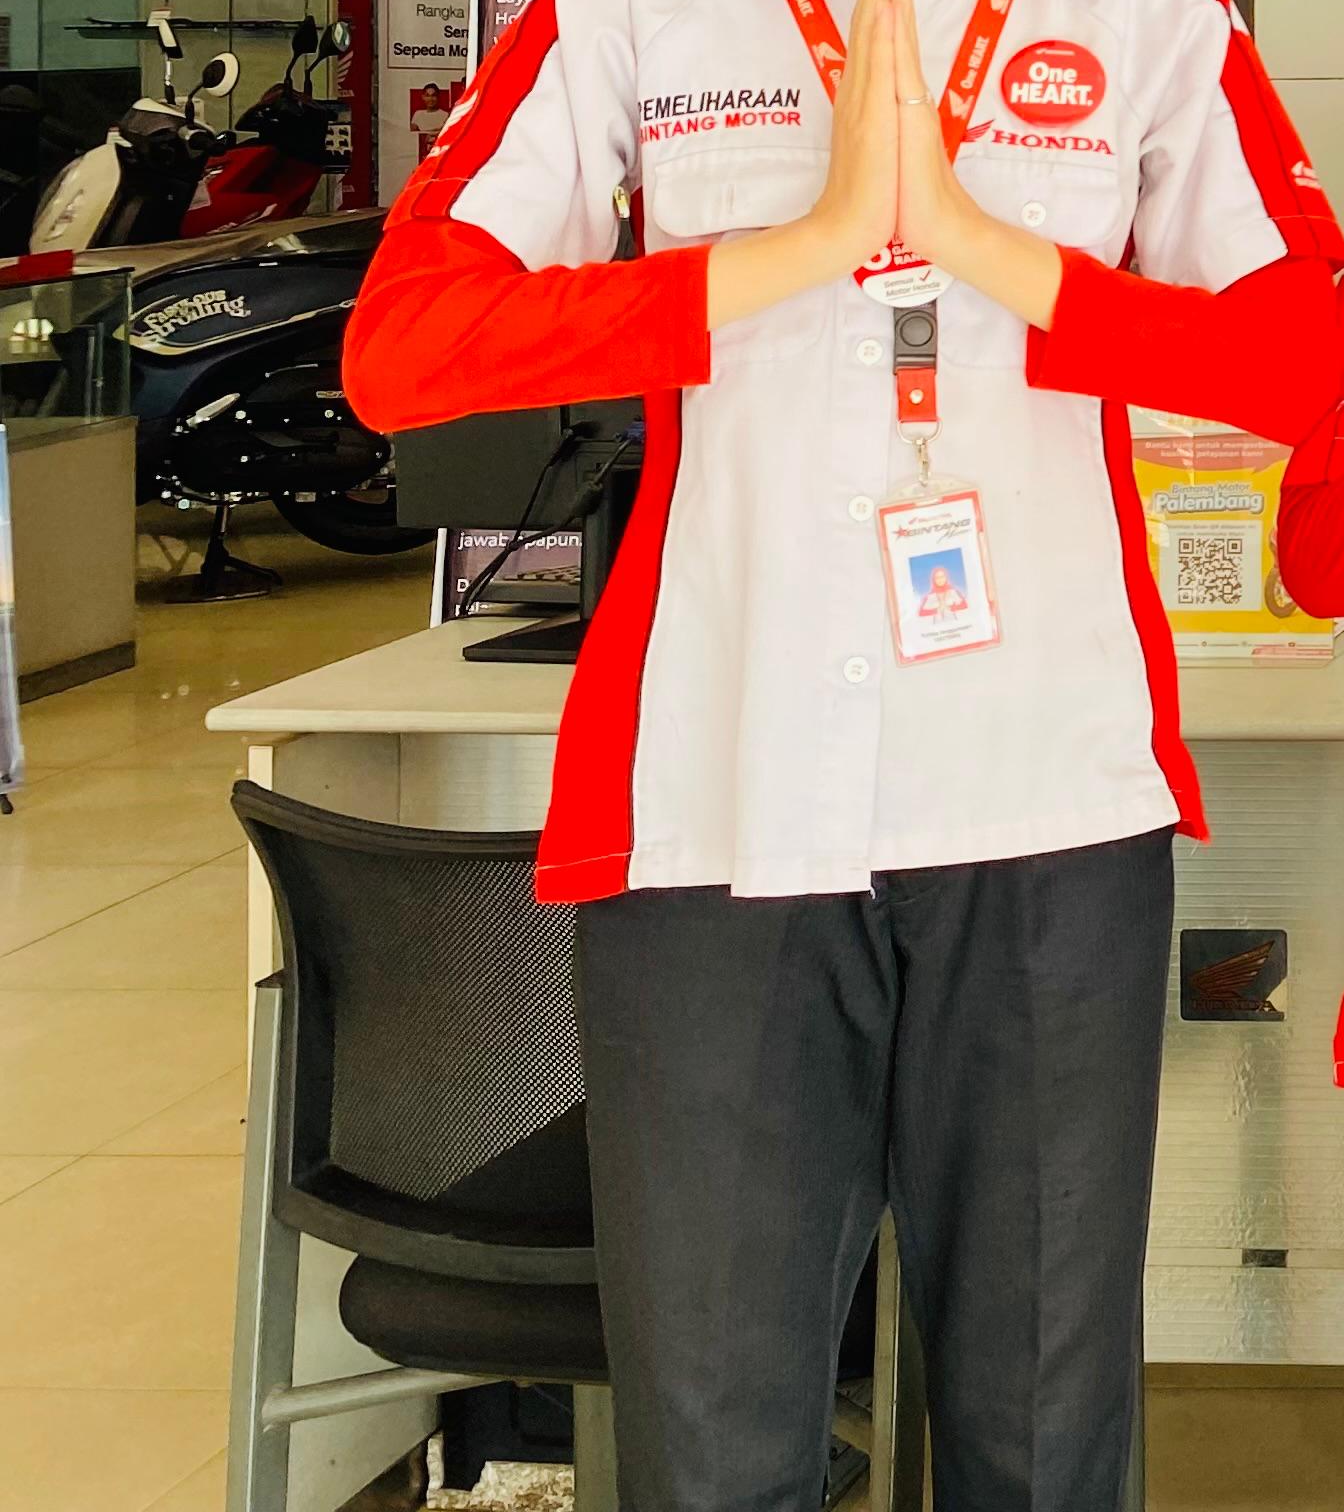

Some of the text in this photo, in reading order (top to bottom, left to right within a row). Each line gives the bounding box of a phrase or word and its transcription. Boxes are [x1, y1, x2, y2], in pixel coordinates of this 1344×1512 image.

[416, 4, 465, 21] Rangka
[393, 43, 445, 59] Sepeda
[1028, 61, 1078, 83] One
[1010, 82, 1094, 106] HEART.
[725, 111, 801, 128] MOTOR
[991, 129, 1115, 156] HONDA
[1154, 492, 1264, 515] Palembang
